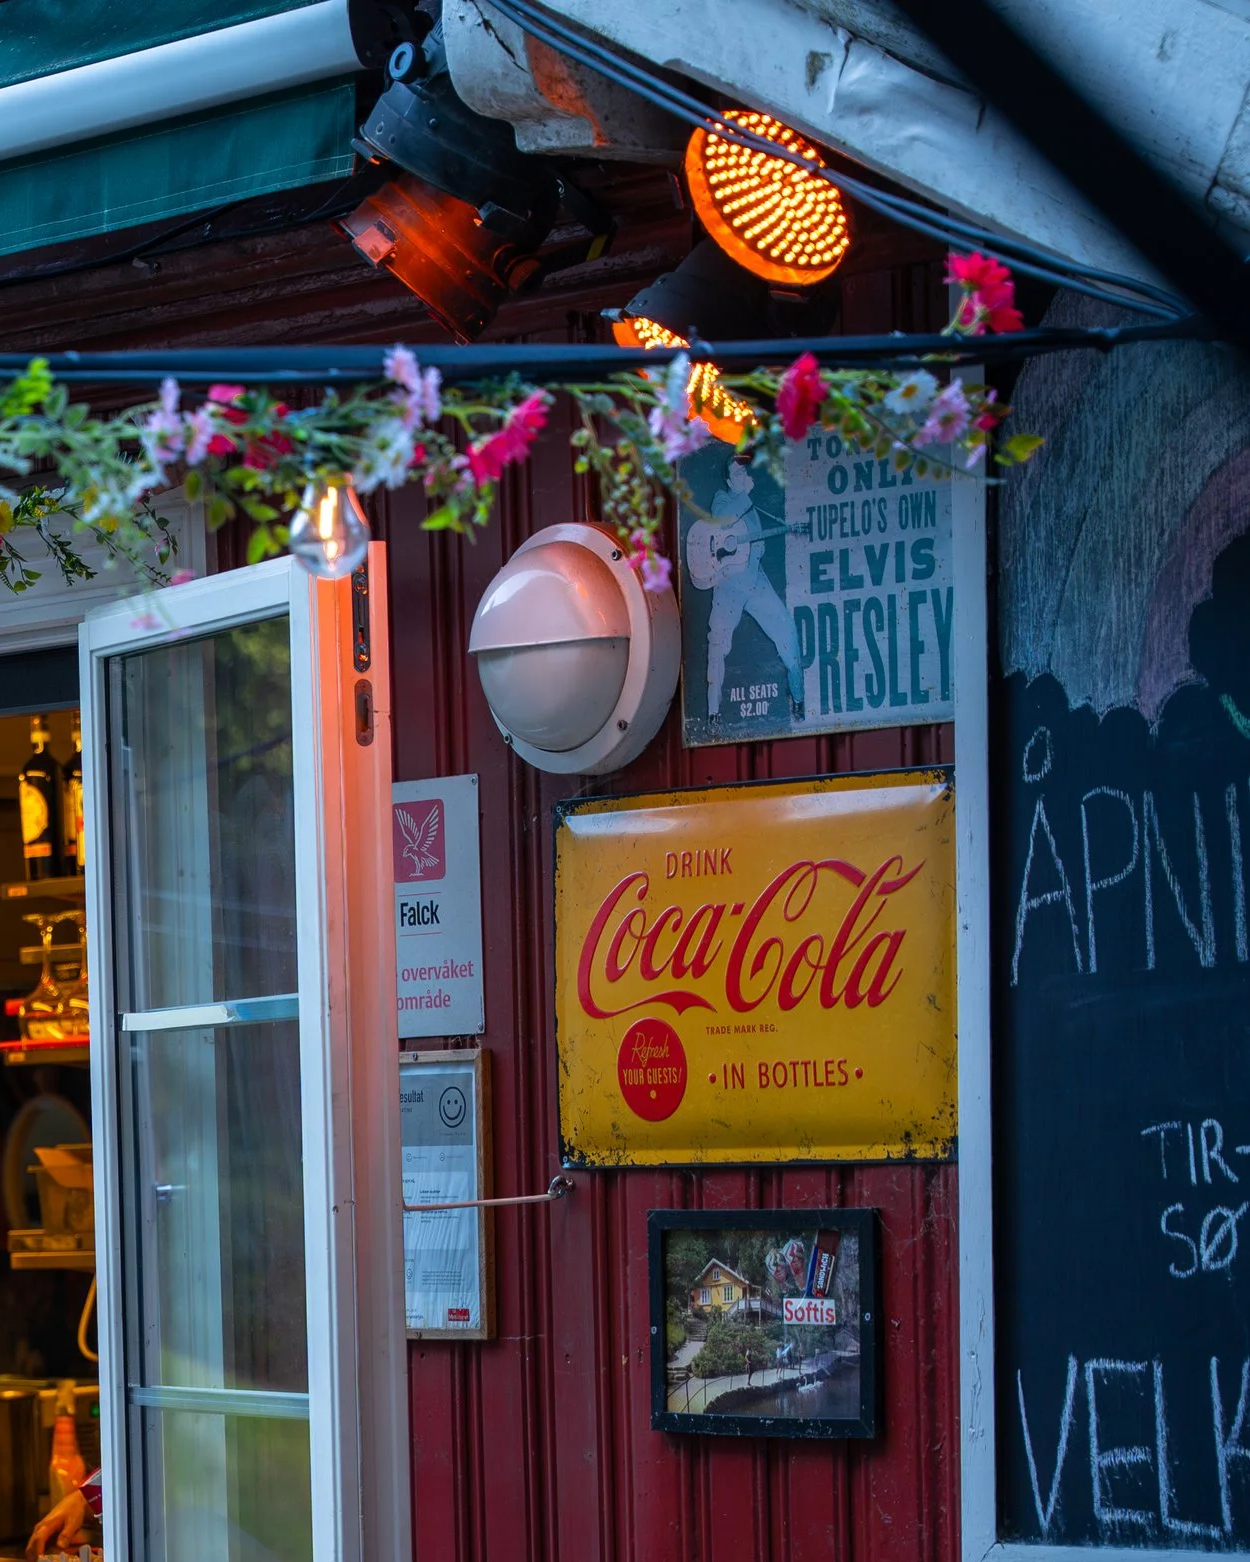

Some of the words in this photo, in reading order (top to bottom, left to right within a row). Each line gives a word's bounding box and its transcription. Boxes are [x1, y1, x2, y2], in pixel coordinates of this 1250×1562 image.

[805, 496, 888, 543] TUPELO'S
[899, 490, 937, 530] OWN
[809, 537, 936, 594] ELVIS
[793, 586, 953, 715] PRESLEY
[730, 687, 746, 702] ALL
[749, 683, 778, 700] SEATS
[740, 701, 768, 719] $2.00
[665, 847, 734, 880] DRINK
[400, 900, 440, 927] Falck
[577, 854, 928, 1020] Coca-Cola
[401, 959, 474, 982] overvåket
[397, 988, 451, 1011] område
[706, 1025, 731, 1035] TRADE
[734, 1024, 757, 1034] MARK
[759, 1023, 779, 1033] REG.
[631, 1032, 670, 1068] Refresh
[622, 1068, 645, 1086] YOUR
[723, 1062, 746, 1090] IN
[758, 1058, 849, 1089] BOTTLES
[398, 1090, 425, 1104] esultat
[784, 1300, 835, 1324] Softis
